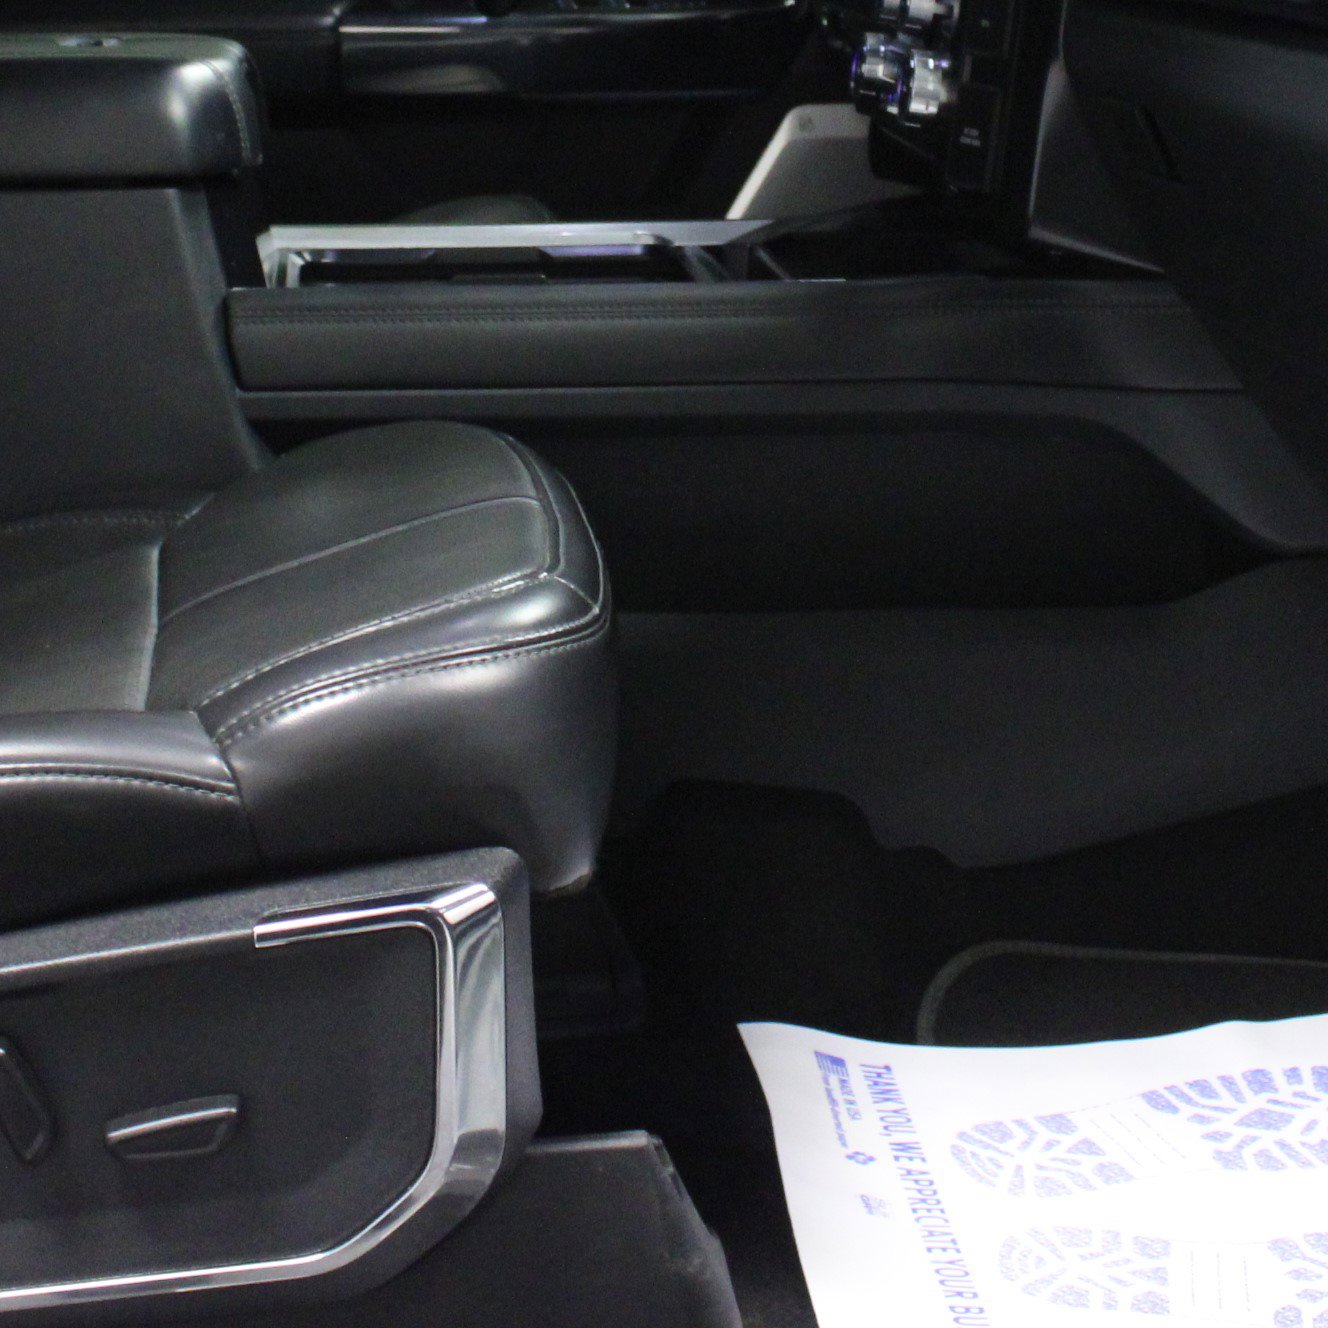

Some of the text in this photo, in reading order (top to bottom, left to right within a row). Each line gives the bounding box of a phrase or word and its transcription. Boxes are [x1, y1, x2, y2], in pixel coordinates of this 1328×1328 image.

[858, 1063, 991, 1328] THANK YOU, WE APPRECIATE YOUR BU
